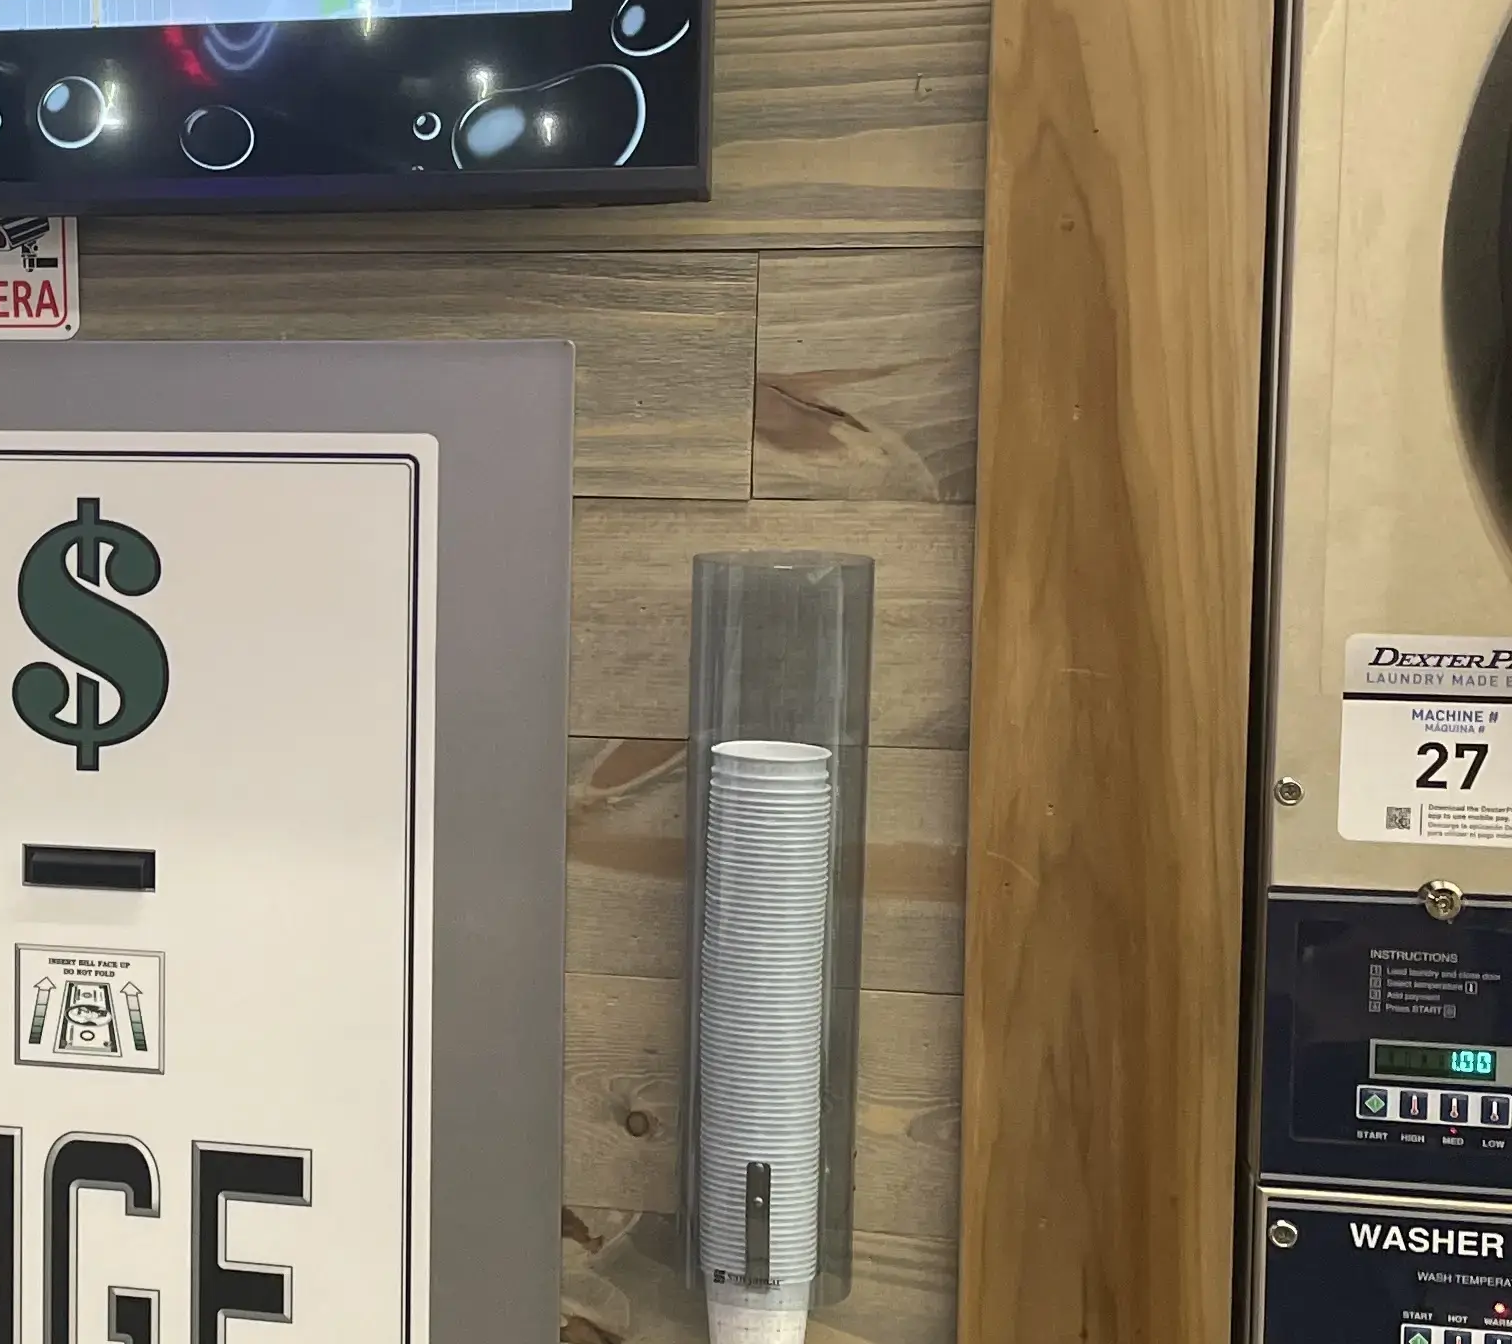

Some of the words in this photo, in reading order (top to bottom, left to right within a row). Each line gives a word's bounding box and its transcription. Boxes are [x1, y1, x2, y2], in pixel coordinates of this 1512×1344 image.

[1368, 647, 1512, 669] DEXTERP
[1367, 672, 1444, 686] LAUNDRY
[1452, 674, 1499, 688] MADE
[1412, 709, 1484, 723] MACHINE
[1416, 742, 1489, 790] 27
[1370, 949, 1458, 963] INSTRUCTIONS
[1357, 1130, 1389, 1140] START
[1400, 1133, 1425, 1143] HIGH
[1442, 1136, 1464, 1146] MED
[1482, 1139, 1505, 1148] LOW
[1350, 1222, 1504, 1258] WASHER
[1417, 1270, 1452, 1284] WASH
[1455, 1273, 1512, 1288] TEMPERA
[1402, 1310, 1433, 1322] START
[1448, 1314, 1468, 1324] HOT
